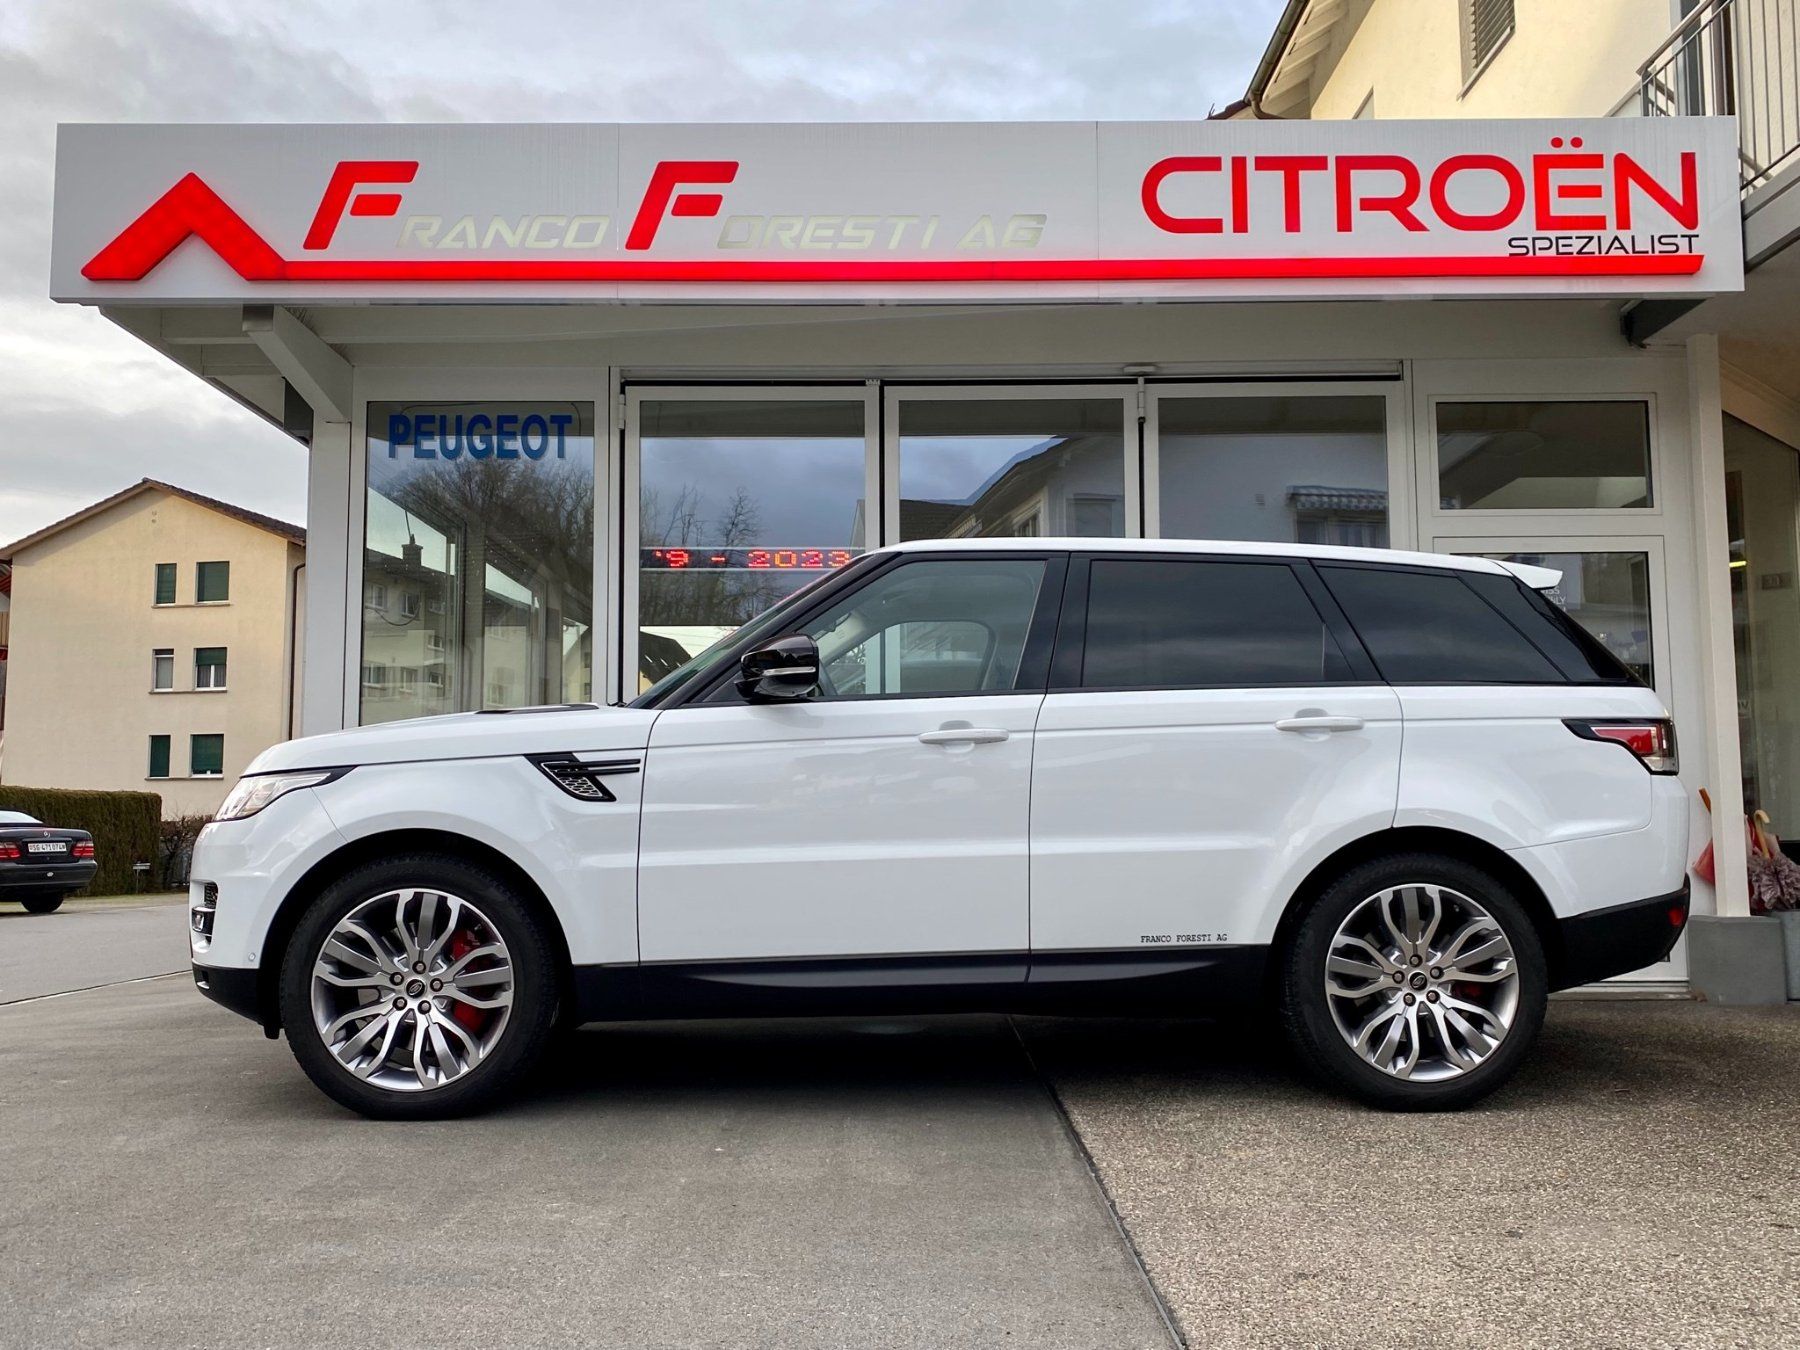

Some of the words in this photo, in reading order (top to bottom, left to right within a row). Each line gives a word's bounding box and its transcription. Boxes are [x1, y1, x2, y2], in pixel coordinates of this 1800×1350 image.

[1141, 137, 1699, 234] CITROËN
[302, 160, 612, 252] FRANCO
[624, 161, 940, 252] FORESTI
[954, 214, 1048, 248] AG
[1508, 234, 1700, 256] SPEZIALIST
[388, 414, 573, 460] PEUGEOT
[748, 550, 850, 568] 2023
[1140, 935, 1172, 943] FRANCO
[1176, 934, 1212, 942] FORESTI
[1216, 934, 1228, 942] AG
